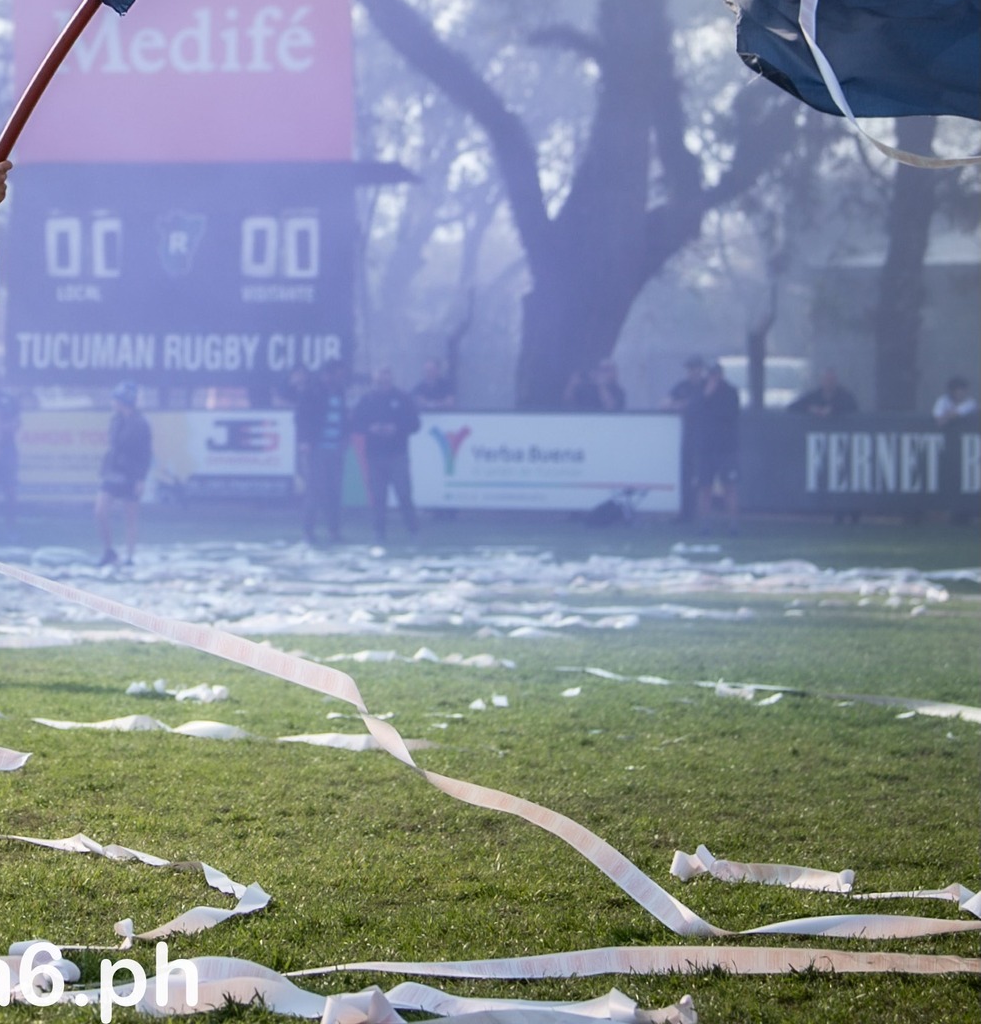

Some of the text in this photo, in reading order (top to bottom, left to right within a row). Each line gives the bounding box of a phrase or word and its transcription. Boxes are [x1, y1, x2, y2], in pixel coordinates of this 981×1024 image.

[53, 5, 314, 74] Medifé
[17, 332, 155, 370] TUCUMAN
[164, 332, 259, 371] RUGBY
[528, 444, 586, 464] Buena
[806, 432, 946, 494] FERNET
